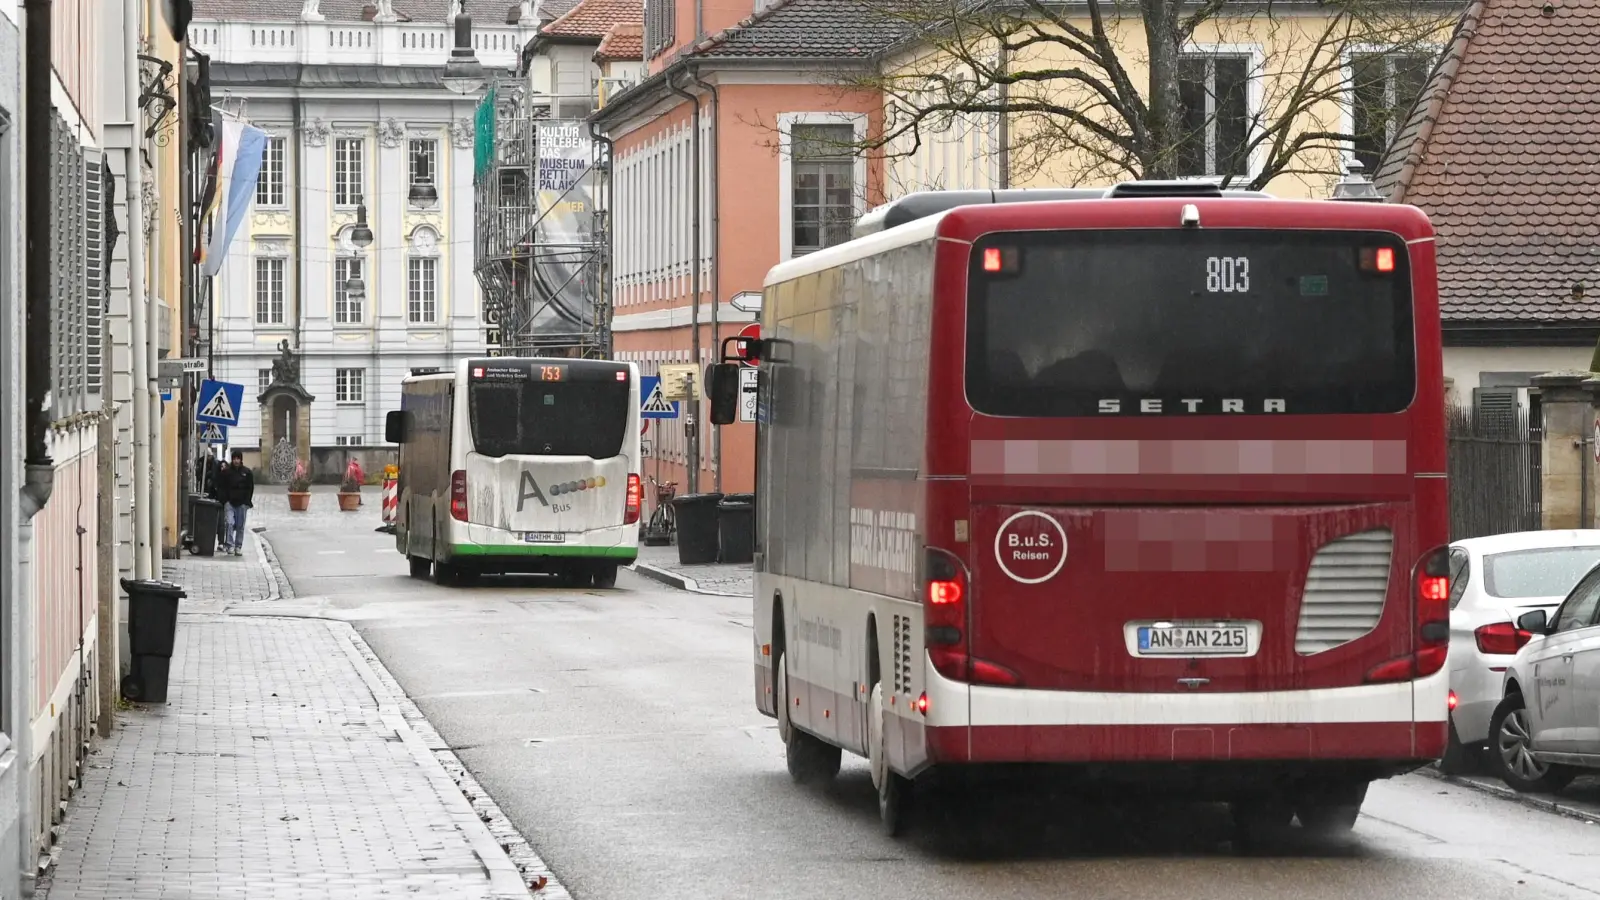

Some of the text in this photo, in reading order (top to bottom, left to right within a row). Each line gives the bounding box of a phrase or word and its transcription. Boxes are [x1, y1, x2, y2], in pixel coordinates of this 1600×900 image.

[540, 126, 579, 138] KULTUR
[540, 138, 586, 148] ERLEBEN
[540, 148, 561, 158] DAS
[540, 158, 585, 169] MUSEUM
[540, 169, 568, 180] RETTI
[539, 179, 575, 191] PALAIS
[1206, 256, 1249, 292] 803
[183, 361, 205, 369] straße
[540, 366, 560, 380] 753
[748, 371, 758, 380] Ta
[1098, 399, 1286, 413] SETRA
[516, 470, 549, 512] A
[552, 503, 571, 514] Bus
[1008, 533, 1053, 547] B.u.S.
[1013, 550, 1049, 560] Reisen
[1150, 630, 1244, 647] AN AN 215
